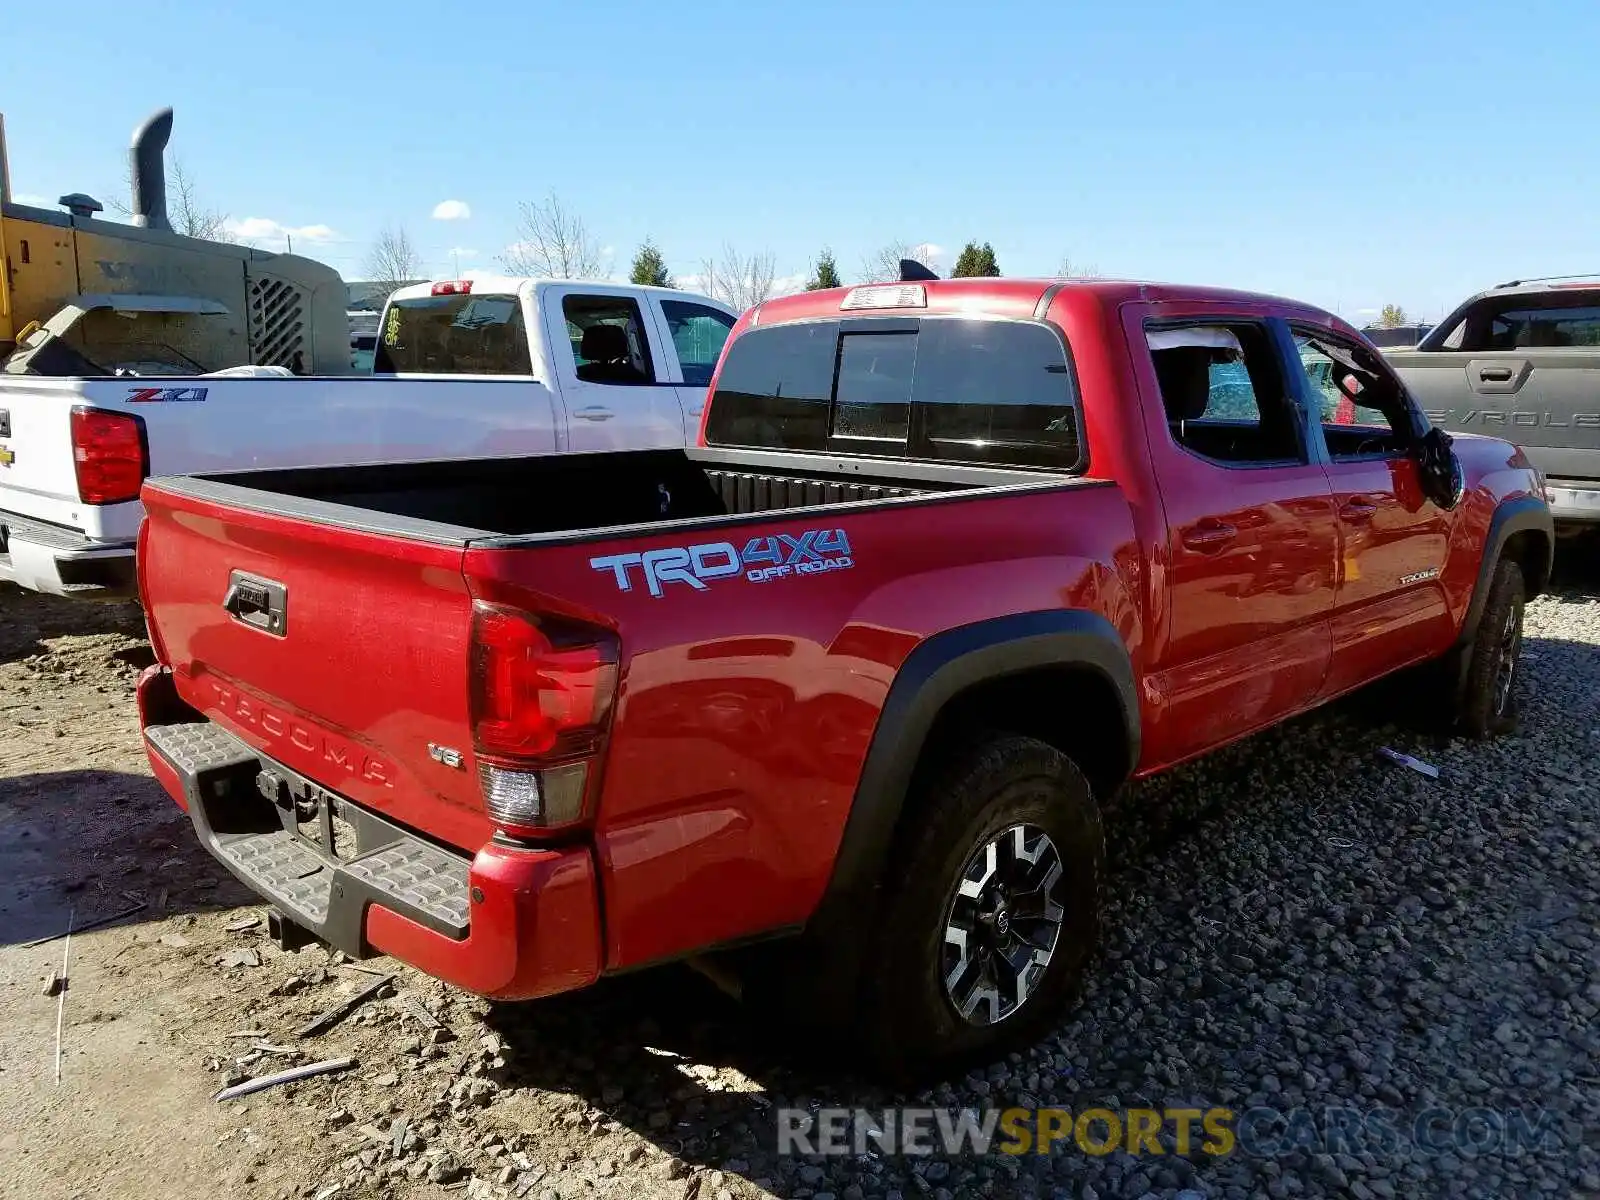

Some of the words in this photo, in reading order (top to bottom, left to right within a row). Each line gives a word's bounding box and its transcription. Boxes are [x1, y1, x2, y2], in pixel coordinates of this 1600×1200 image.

[590, 542, 743, 598] TRD
[211, 683, 395, 788] TACOMA
[427, 743, 464, 768] V6
